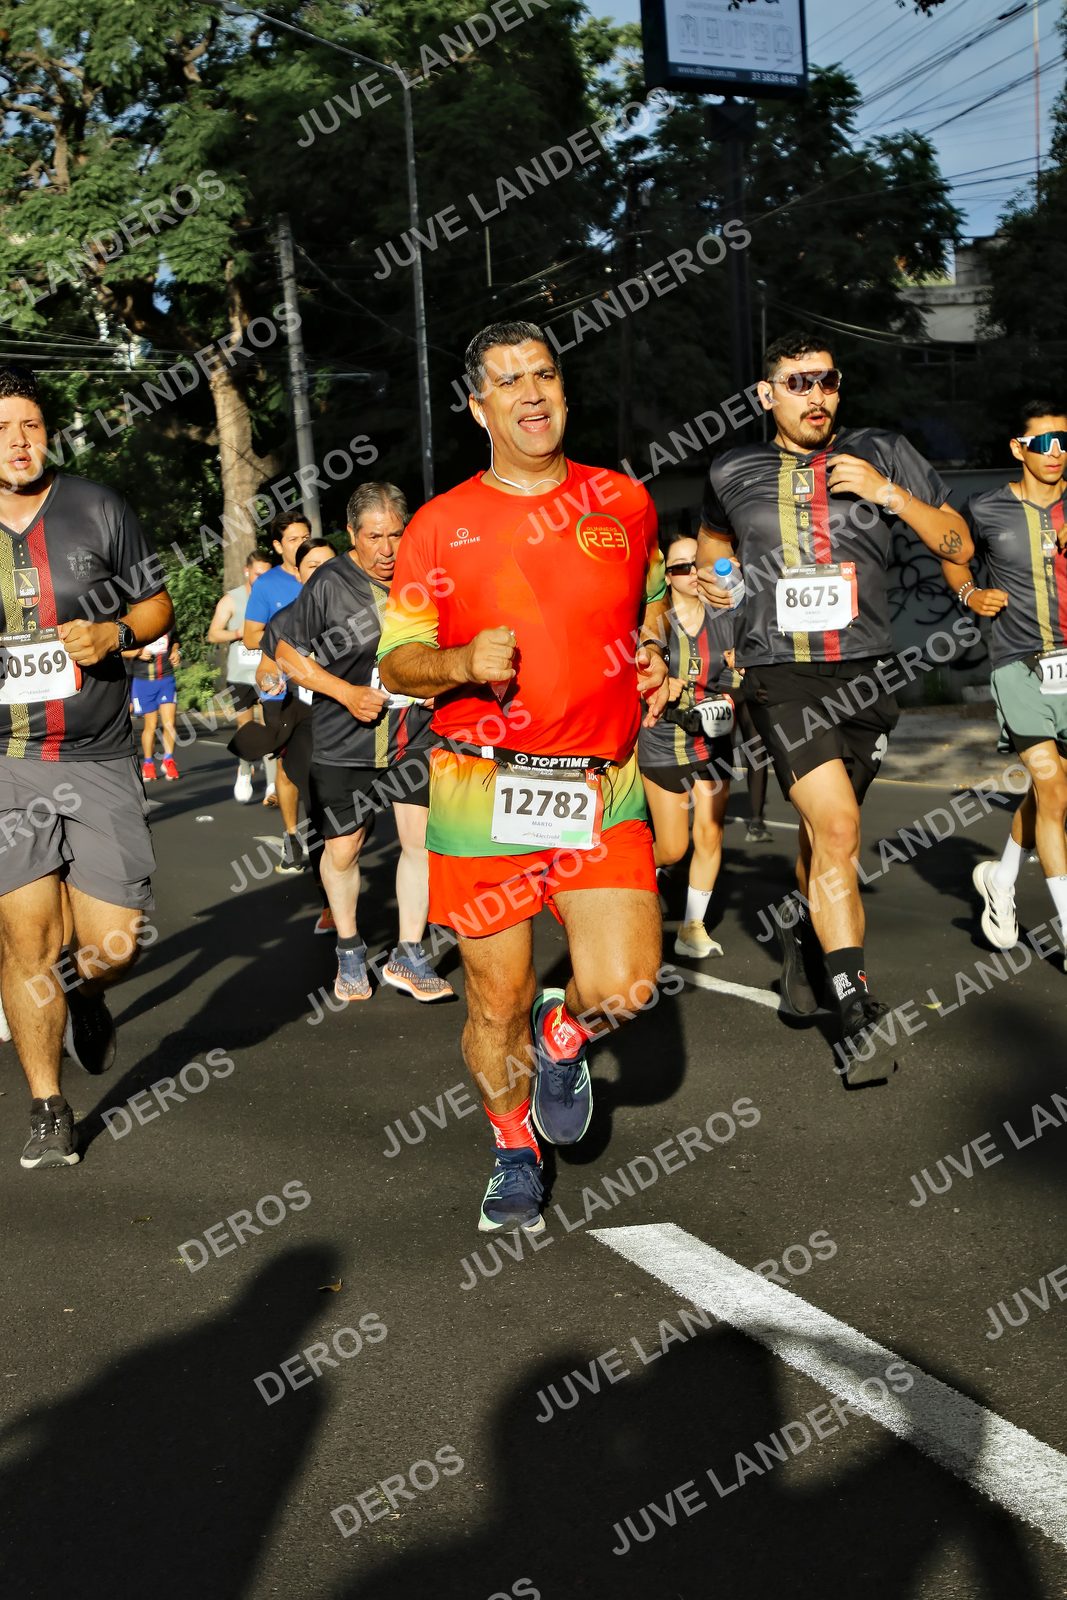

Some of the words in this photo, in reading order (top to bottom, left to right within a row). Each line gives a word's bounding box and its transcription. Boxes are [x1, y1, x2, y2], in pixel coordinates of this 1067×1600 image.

[450, 535, 481, 548] TOPTIME
[583, 531, 625, 548] R23
[785, 585, 839, 608] 8675
[0, 649, 67, 679] 0569
[1047, 662, 1067, 680] 11
[702, 706, 732, 721] 11229
[530, 756, 591, 769] TOPTIME
[500, 787, 588, 821] 12782
